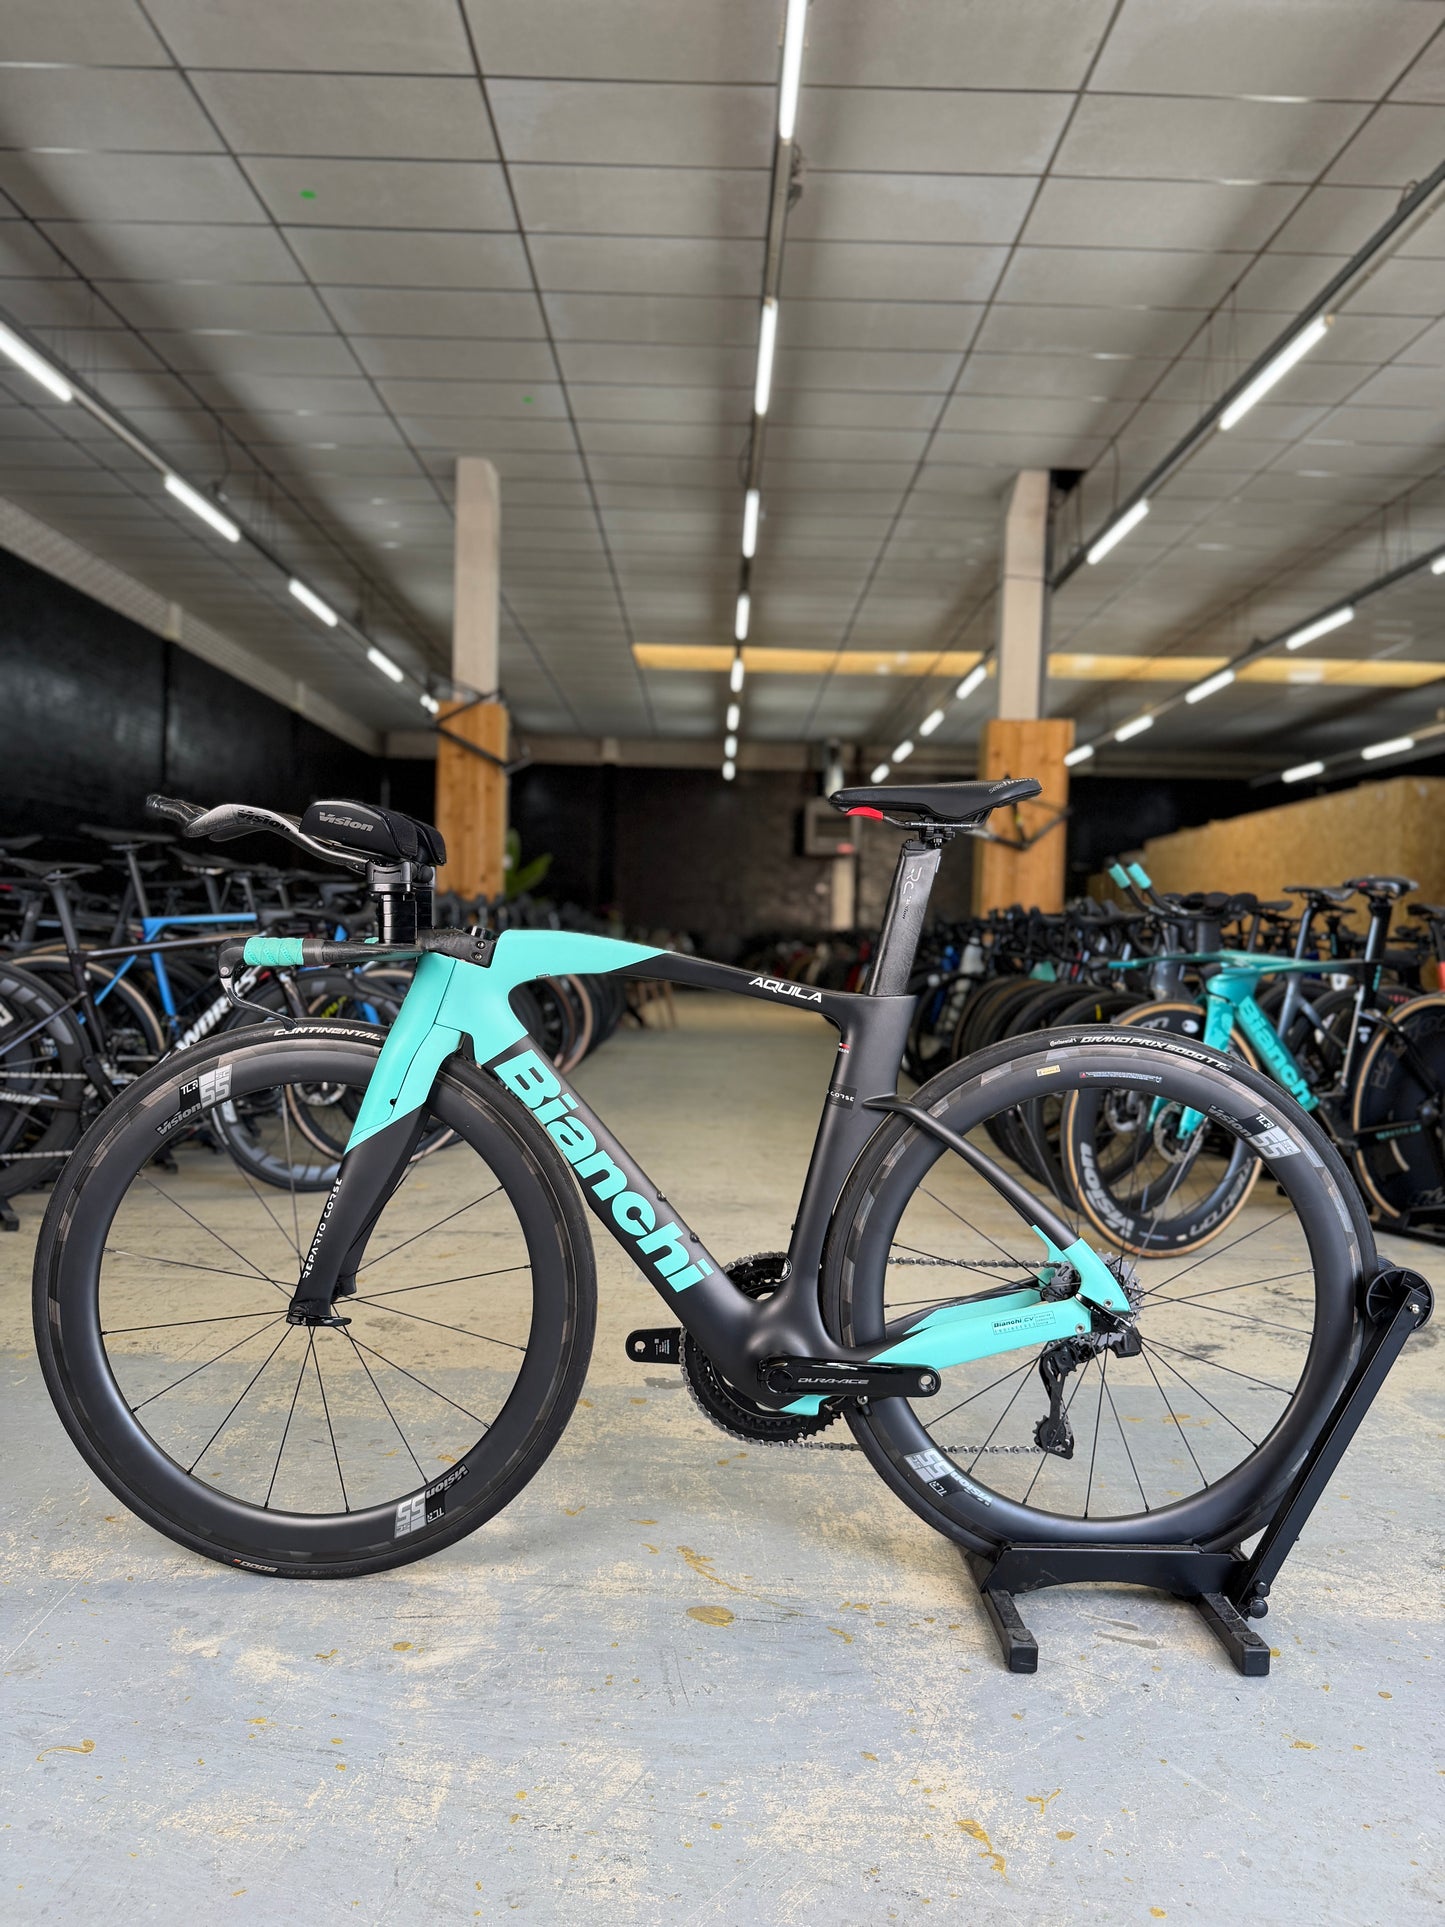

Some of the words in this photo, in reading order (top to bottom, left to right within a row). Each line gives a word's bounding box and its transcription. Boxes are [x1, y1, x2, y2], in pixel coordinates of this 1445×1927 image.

[318, 812, 374, 832] Vision
[749, 977, 822, 1003] AQUILA
[1080, 1036, 1130, 1044] GRAND
[1129, 1037, 1168, 1049] PRIX
[1166, 1044, 1206, 1060] 5000
[1239, 996, 1319, 1112] Bianchi
[156, 1102, 201, 1135] Vision
[201, 1077, 231, 1108] 55
[1208, 1105, 1252, 1137] Vision
[1248, 1131, 1287, 1159] 55
[493, 1049, 714, 1293] Bianchi
[302, 1222, 326, 1279] REPARTO
[323, 1178, 343, 1219] CORSE
[426, 1465, 469, 1499] Vision
[951, 1471, 993, 1506] Vision
[397, 1491, 426, 1522] 55
